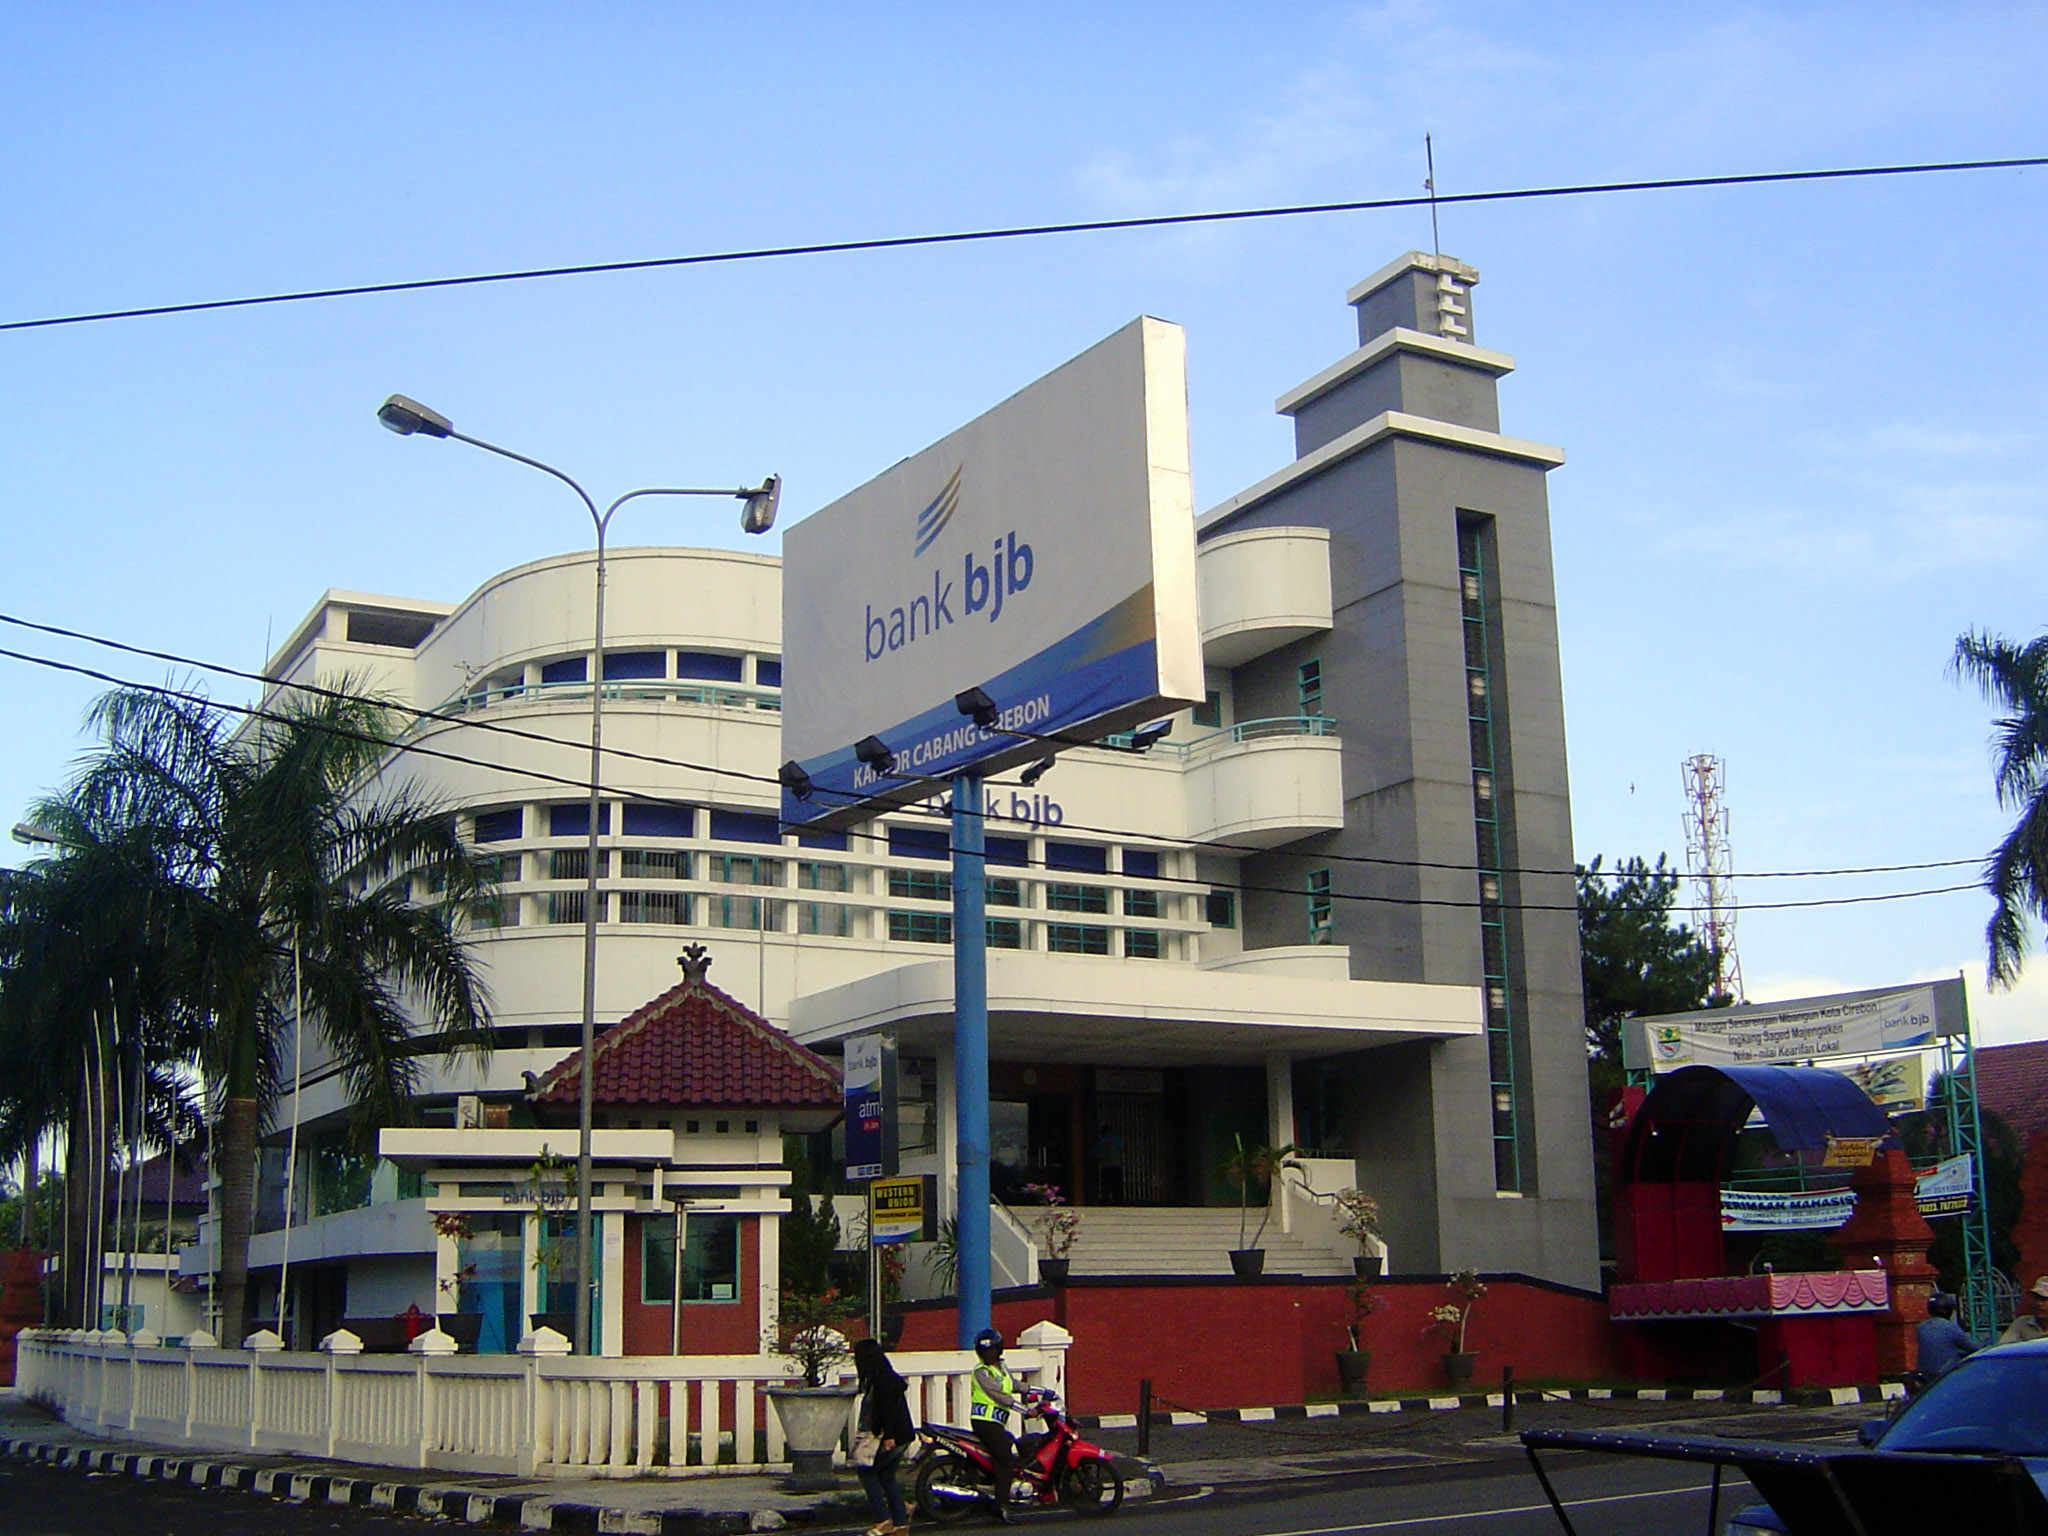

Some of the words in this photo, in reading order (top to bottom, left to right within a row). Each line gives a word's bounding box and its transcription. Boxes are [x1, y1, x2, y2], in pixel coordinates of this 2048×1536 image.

[866, 570, 954, 662] bank
[965, 530, 1033, 623] bjb
[854, 750, 910, 789] KAOR
[912, 724, 976, 766] CABANG
[1011, 791, 1063, 831] bjb
[1842, 1001, 1878, 1016] Cirebon
[1884, 1016, 1909, 1028] bank
[1910, 1013, 1930, 1026] bjb
[1778, 1043, 1814, 1057] Kearifan
[1816, 1040, 1840, 1053] Lokal
[859, 1100, 880, 1119] atm
[876, 1186, 914, 1198] WESTERN
[888, 1197, 914, 1208] UNION
[936, 1435, 968, 1459] HONDA
